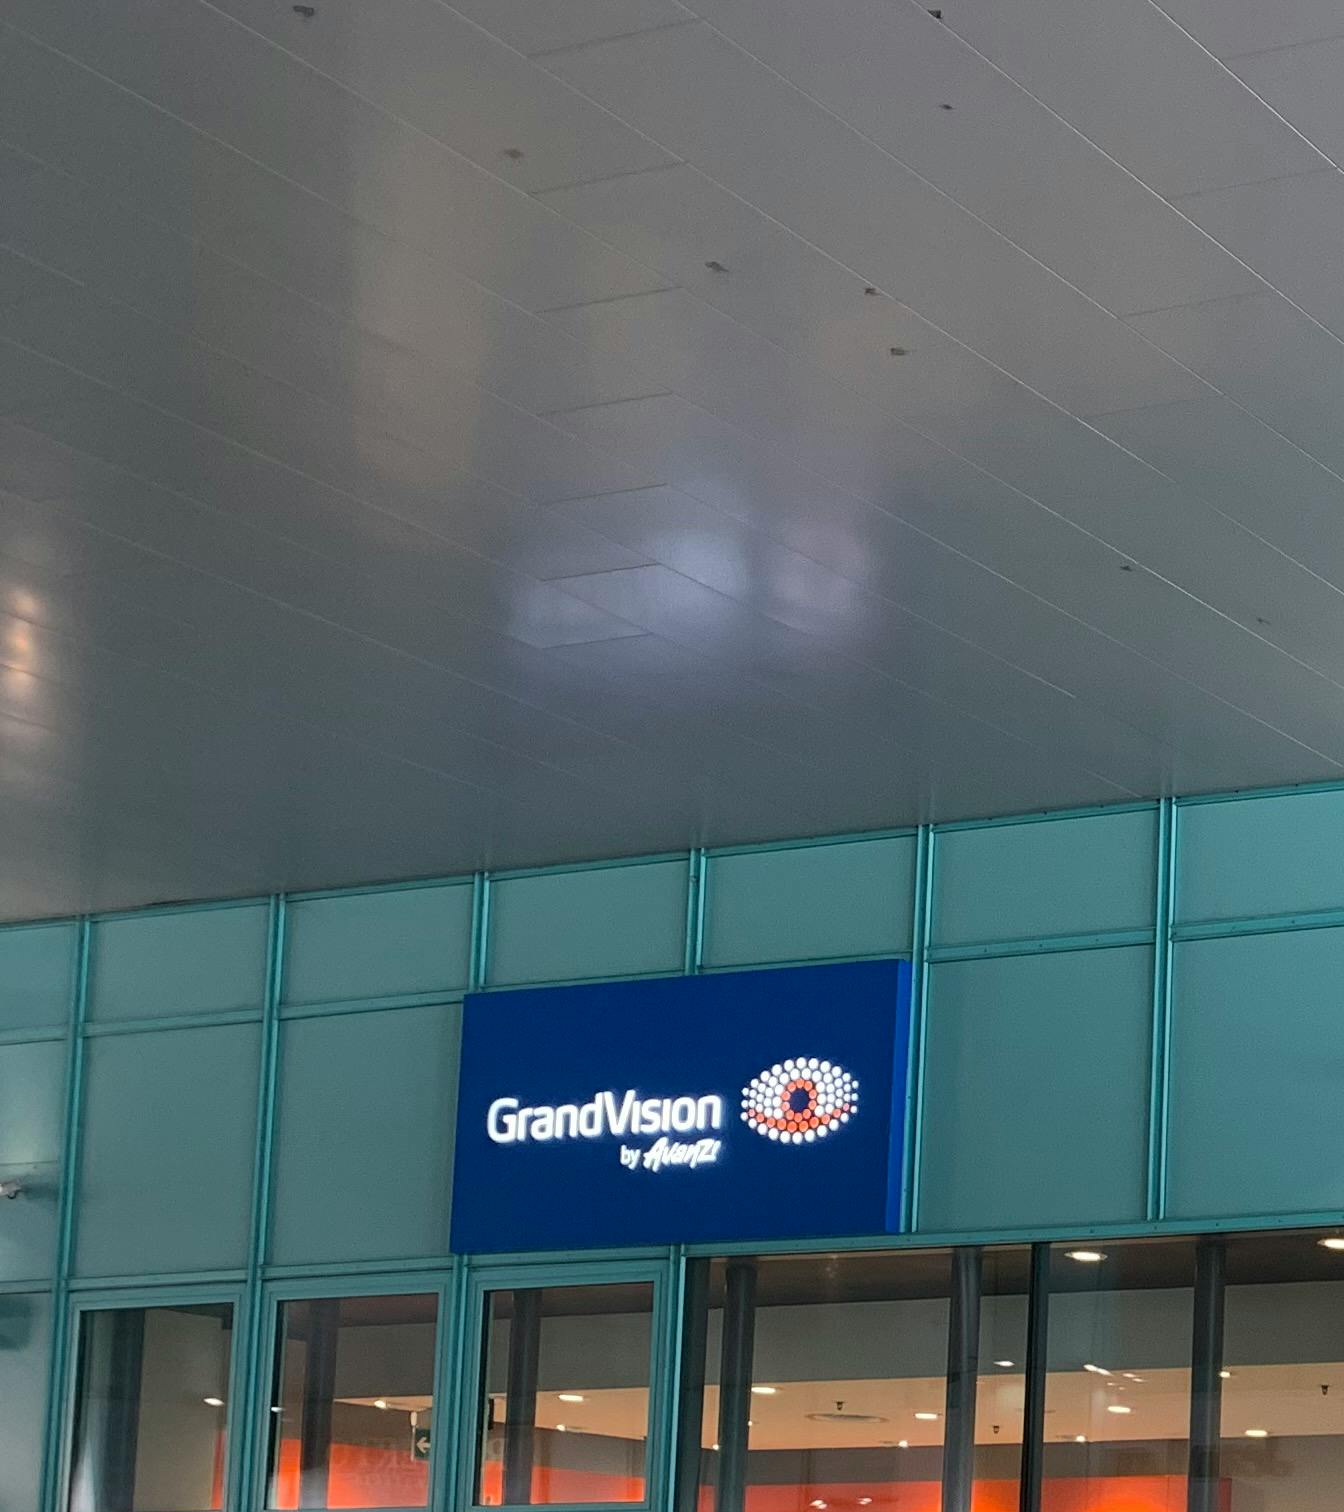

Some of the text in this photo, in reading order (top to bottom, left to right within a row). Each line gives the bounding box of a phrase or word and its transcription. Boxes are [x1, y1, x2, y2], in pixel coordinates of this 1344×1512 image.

[486, 1088, 722, 1144] GrandVision
[619, 1136, 722, 1173] by Avanzi
